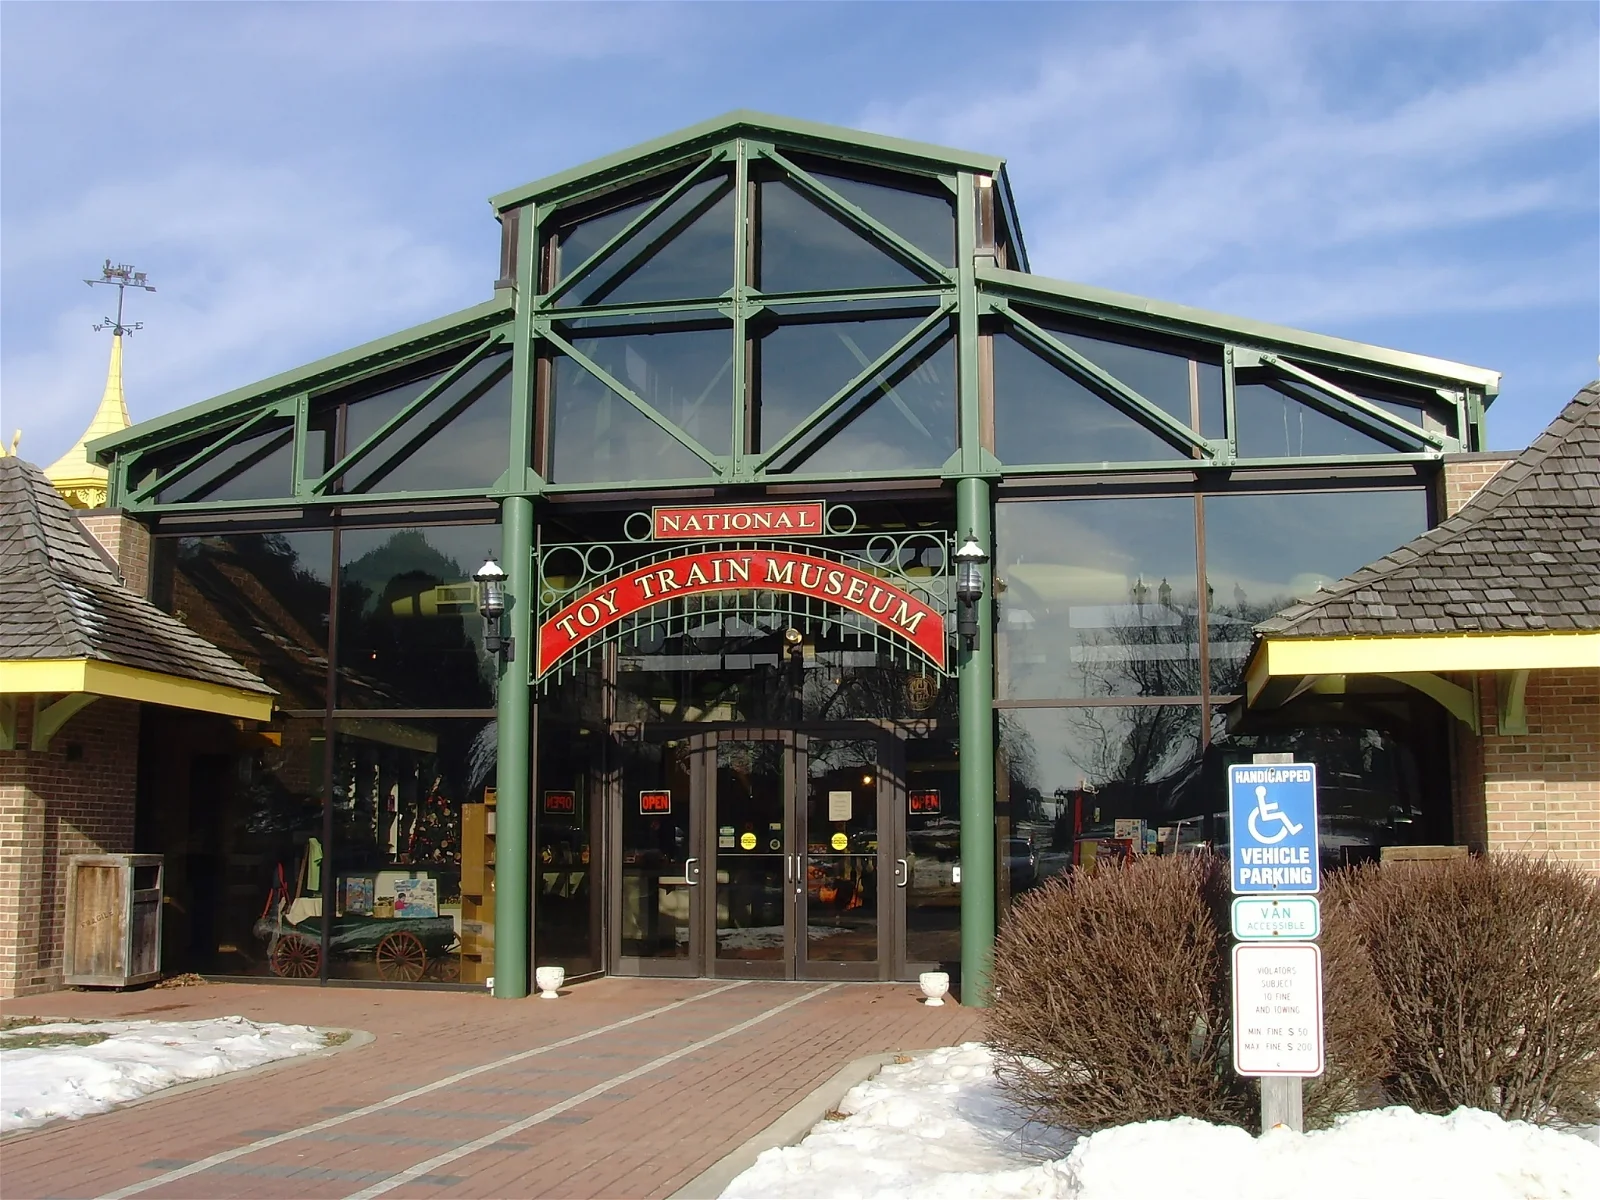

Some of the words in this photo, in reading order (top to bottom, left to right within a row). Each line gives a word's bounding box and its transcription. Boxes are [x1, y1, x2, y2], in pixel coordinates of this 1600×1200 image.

[92, 324, 103, 332] W
[135, 321, 144, 330] E
[661, 511, 815, 532] NATIONAL
[555, 587, 619, 641] TOY
[634, 557, 752, 600] TRAIN
[765, 557, 927, 635] MUSEUM
[1235, 768, 1311, 784] HANDICAPPED
[642, 795, 668, 810] OPEN
[911, 794, 939, 810] OPEN
[1240, 847, 1310, 865] VEHICLE
[1239, 867, 1312, 885] PARKING
[1260, 907, 1291, 919] VAN
[80, 911, 114, 928] FRAGILE
[1247, 921, 1306, 931] ACCESSIBLE
[1257, 966, 1297, 975] VIOLATORS
[1261, 979, 1293, 988] SUBJECT
[1263, 992, 1273, 1001] TO
[1275, 992, 1291, 1001] FINE
[1255, 1005, 1271, 1014] AND
[1274, 1005, 1301, 1014] TOWING
[1266, 1027, 1283, 1037] FINE
[1265, 1042, 1282, 1052] FINE
